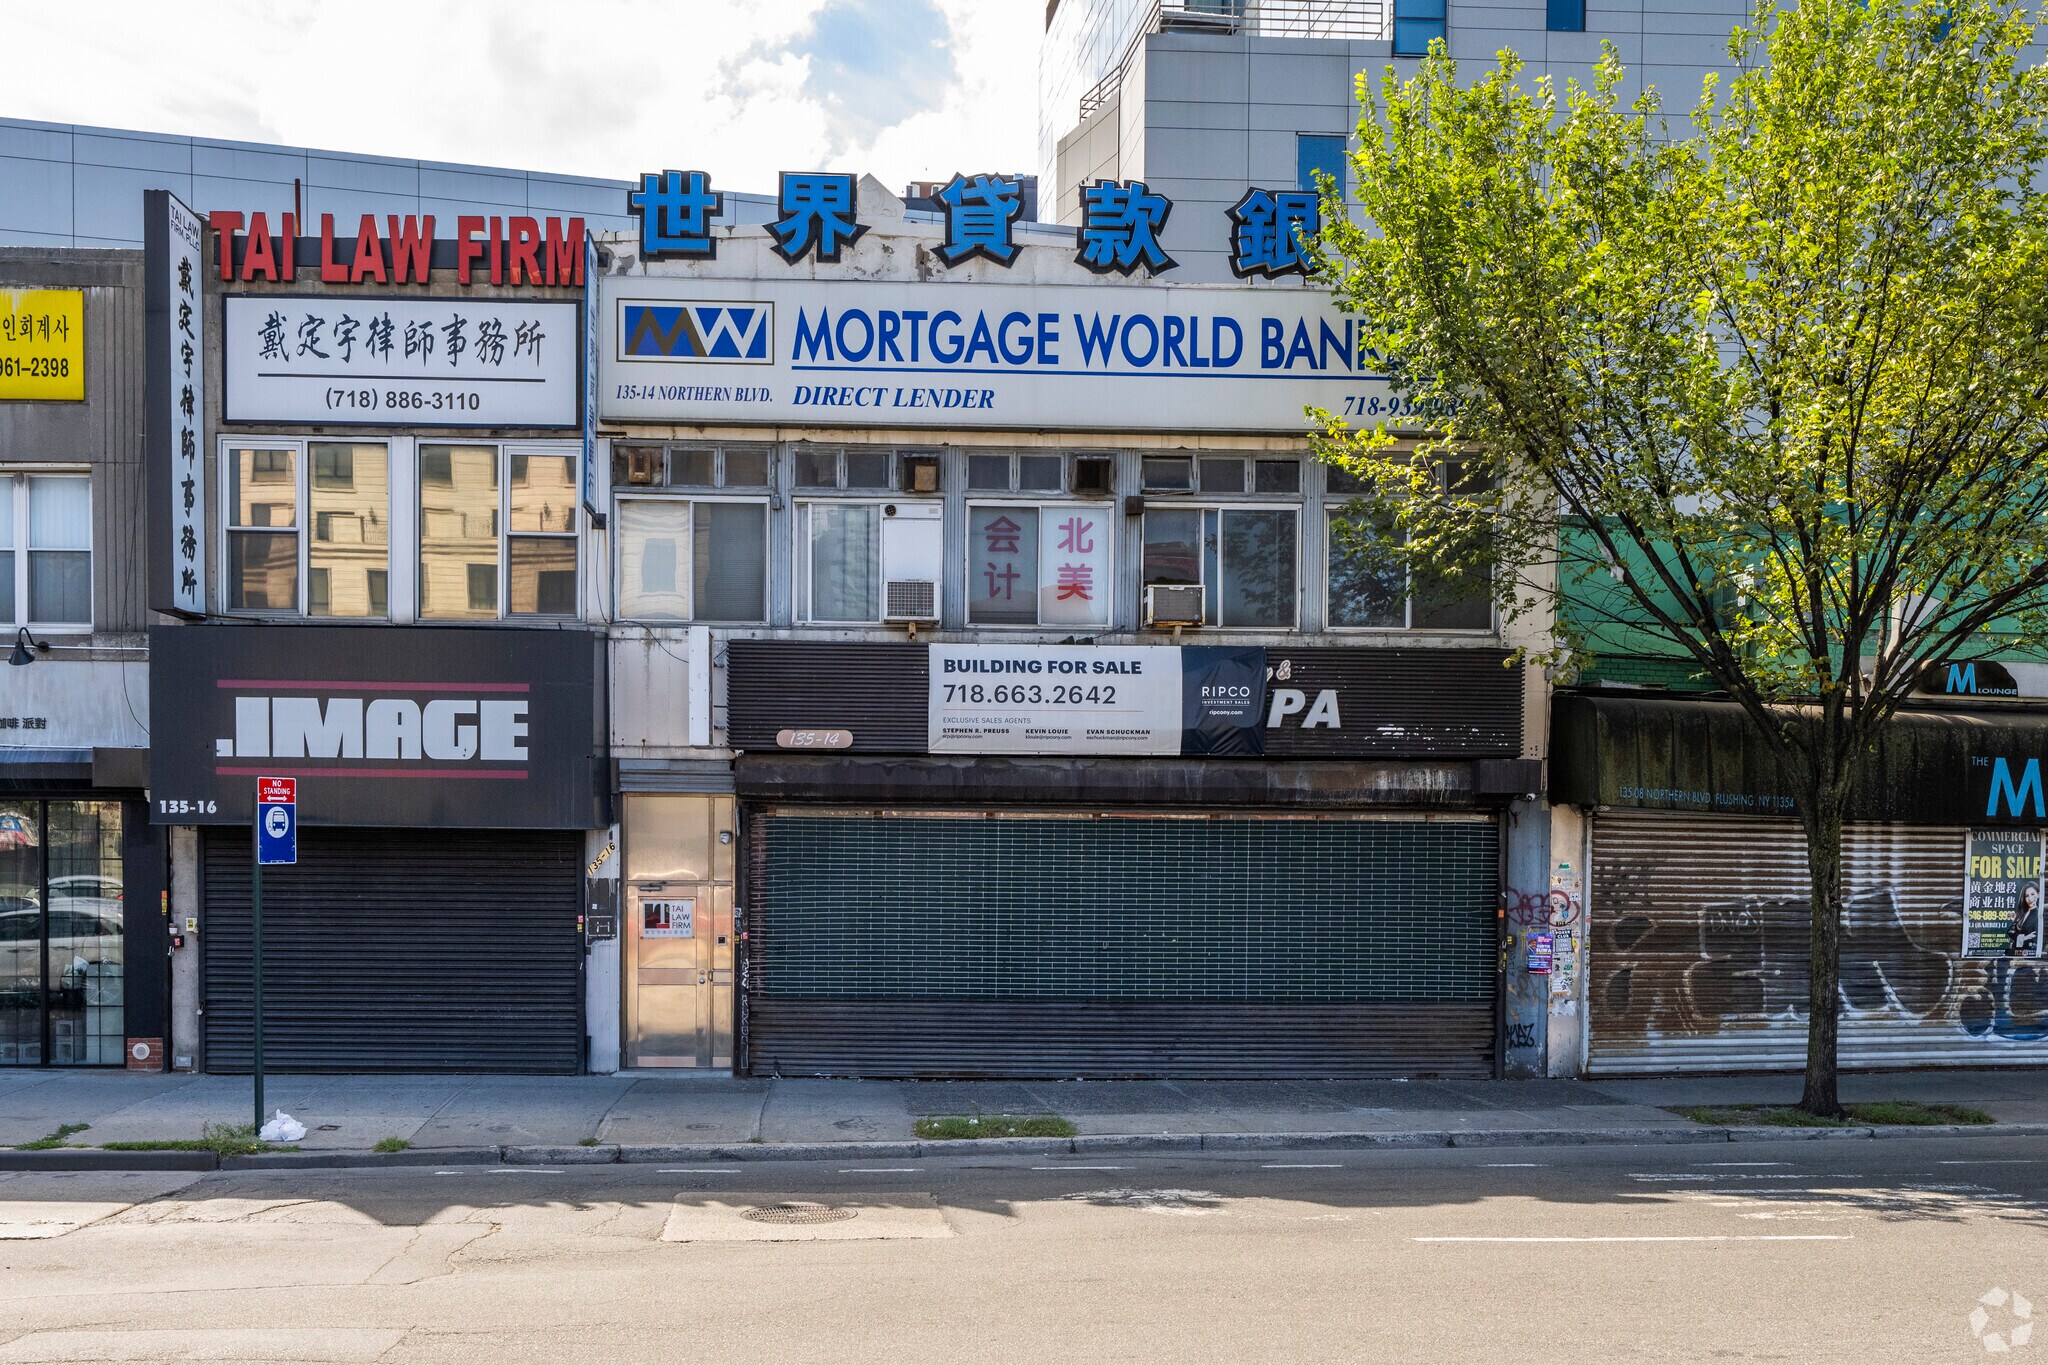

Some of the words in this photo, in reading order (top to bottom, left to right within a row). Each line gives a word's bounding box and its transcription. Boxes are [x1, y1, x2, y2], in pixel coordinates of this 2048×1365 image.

[209, 211, 296, 282] TAI
[321, 213, 436, 284] LAW
[458, 215, 586, 286] FIRM
[2, 313, 70, 343] 인회계사
[258, 310, 546, 367] 戴定宇律師事務所
[792, 305, 1059, 366] MORTGAGE
[1074, 313, 1244, 370] WORLD
[325, 387, 378, 411] (718)
[385, 391, 480, 412] 886-3110
[616, 384, 655, 401] 135-14
[658, 385, 731, 402] NORTHERN
[734, 386, 773, 403] BLVD.
[792, 385, 888, 408] DIRECT
[892, 387, 995, 410] LENDER
[984, 515, 1021, 600] 会计
[1057, 517, 1094, 600] 北美
[943, 659, 1042, 674] BUILDING
[1047, 660, 1088, 674] FOR
[1092, 661, 1142, 675] SALE
[1946, 663, 1976, 693] M
[942, 684, 1116, 704] 718.663.2642
[1202, 686, 1250, 697] RIPCO
[1267, 689, 1341, 729] PA
[789, 732, 840, 746] 135-14
[263, 787, 291, 795] STANDING
[1646, 788, 1690, 802] NORTHERN
[1759, 796, 1770, 808] NY
[1971, 756, 1989, 767] THE
[1986, 757, 2046, 818] M
[159, 800, 218, 814] 135-16
[588, 842, 616, 875] 135-16
[1991, 844, 2025, 854] SPACE
[1970, 855, 2002, 879] FOR
[2006, 856, 2041, 879] SALE
[671, 913, 690, 921] LAW
